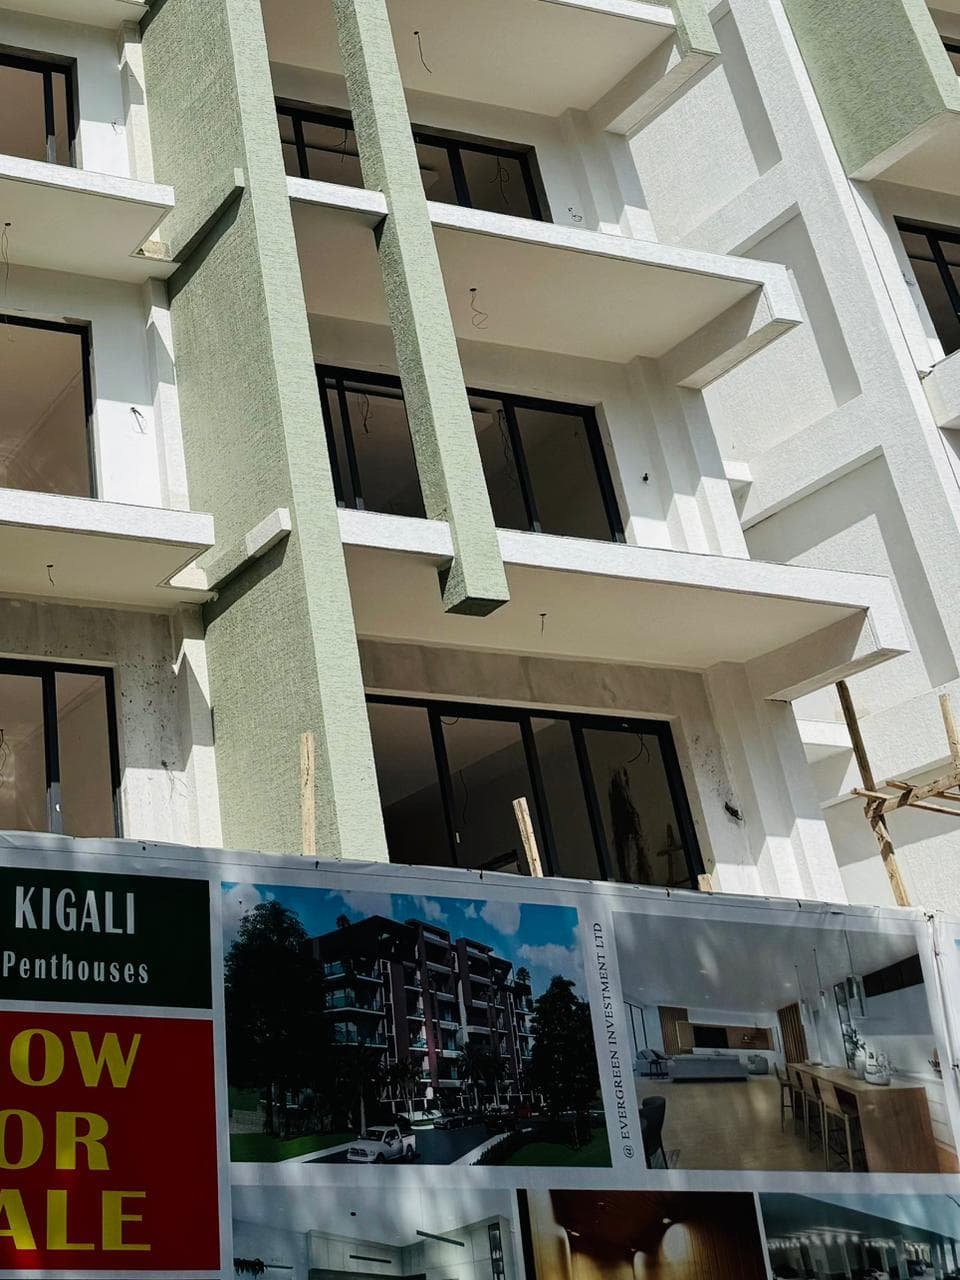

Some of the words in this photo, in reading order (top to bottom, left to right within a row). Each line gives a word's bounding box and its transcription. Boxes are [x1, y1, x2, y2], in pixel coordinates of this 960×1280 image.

[15, 885, 136, 935] KIGALI
[593, 922, 604, 949] LTD
[2, 951, 149, 984] Penthouses
[597, 953, 617, 1045] INVESTMENT
[610, 1050, 631, 1139] EVERGREEN
